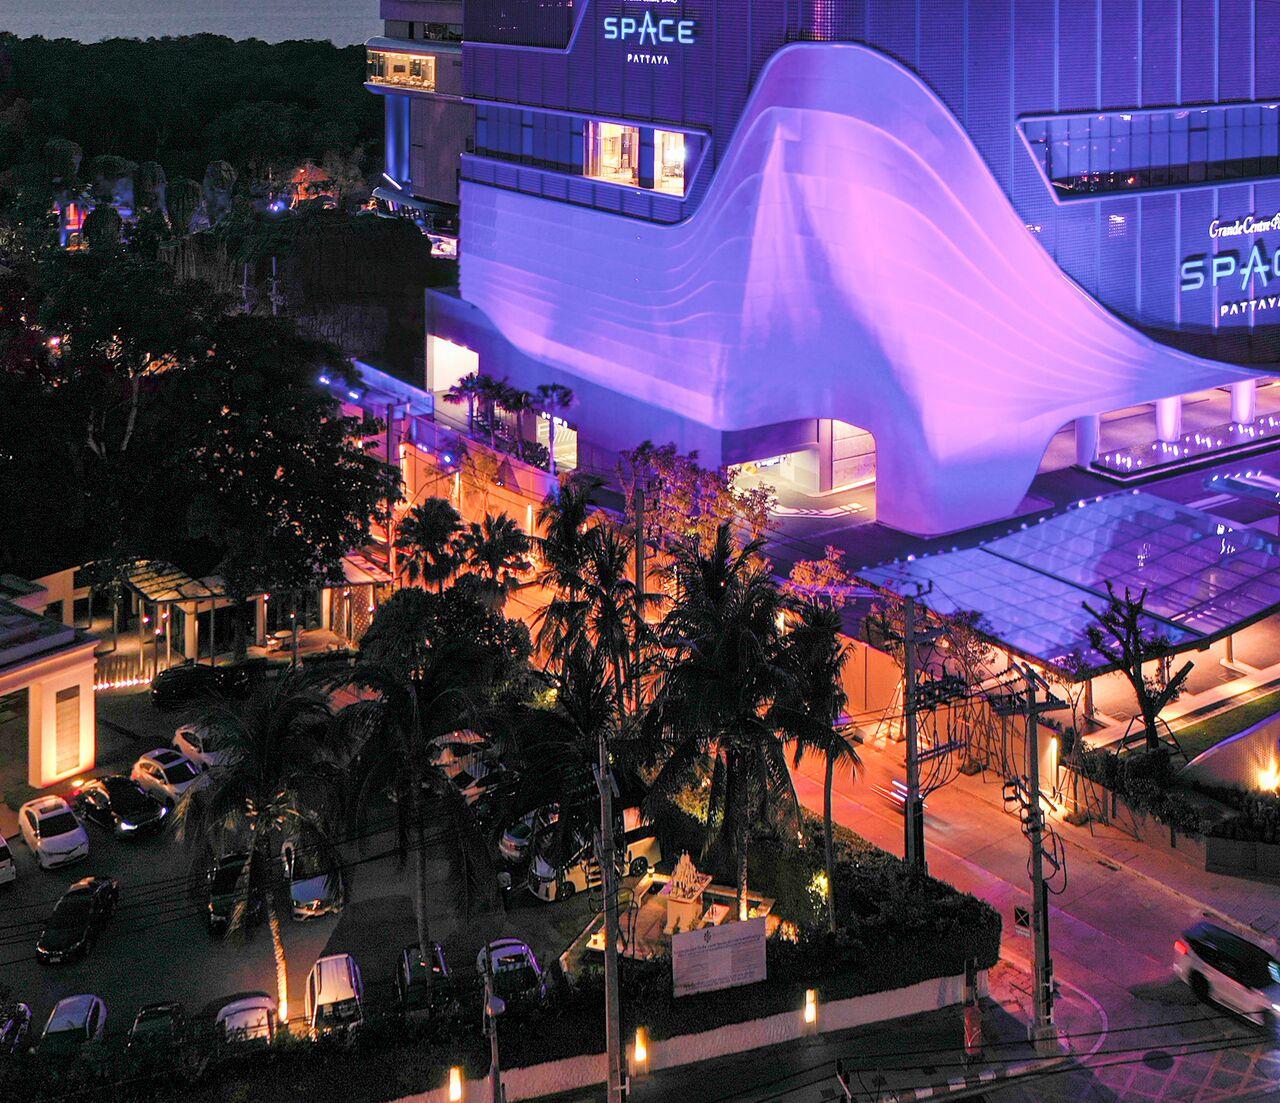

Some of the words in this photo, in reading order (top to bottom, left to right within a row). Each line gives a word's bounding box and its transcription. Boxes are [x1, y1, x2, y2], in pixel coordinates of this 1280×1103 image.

[604, 11, 696, 46] SPACE
[627, 53, 669, 65] PATTAYA
[1209, 220, 1244, 239] Grande
[1242, 216, 1272, 235] Centre
